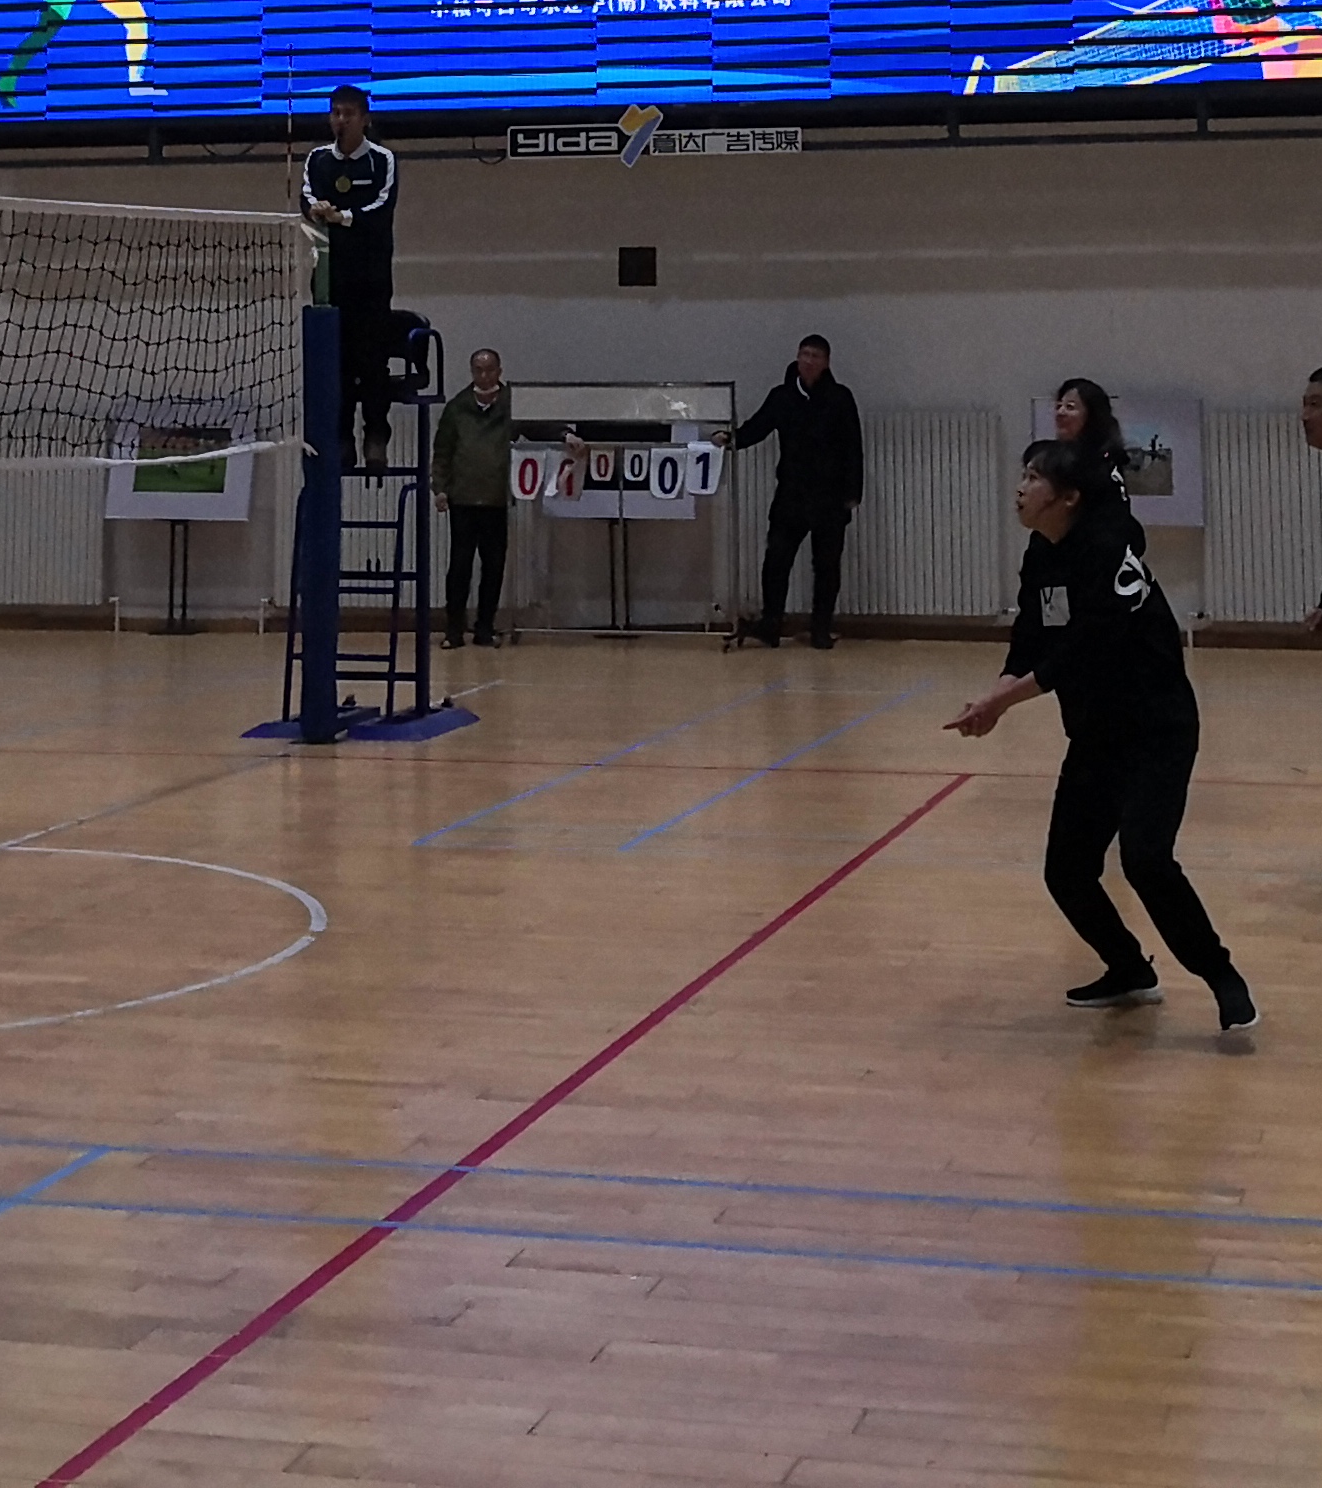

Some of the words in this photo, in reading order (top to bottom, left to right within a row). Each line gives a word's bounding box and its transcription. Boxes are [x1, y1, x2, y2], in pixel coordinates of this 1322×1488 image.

[651, 129, 800, 154] 意达广告传媒
